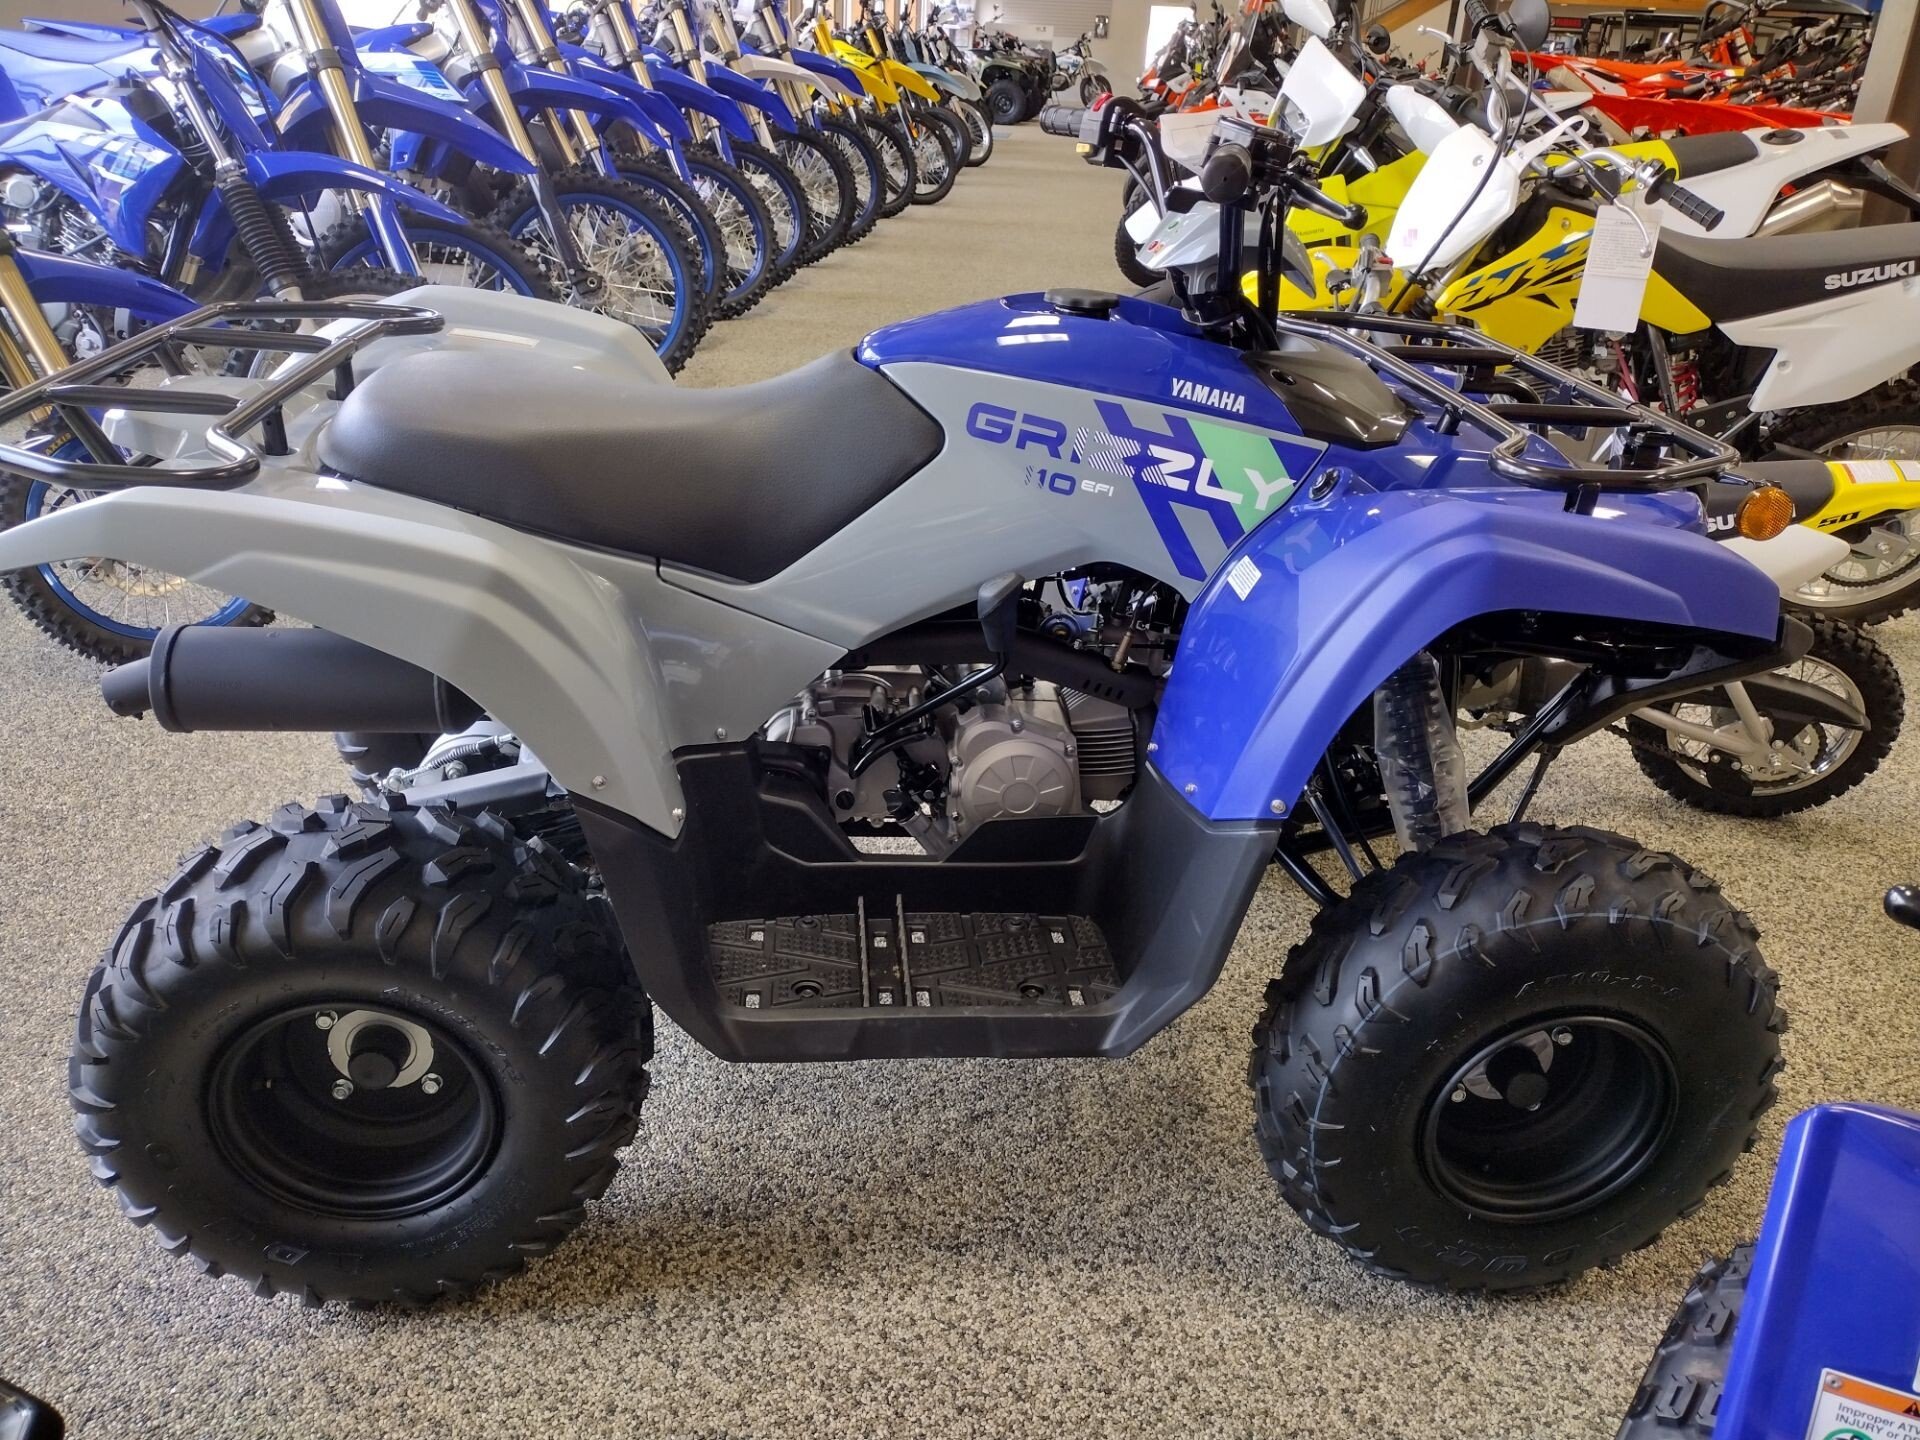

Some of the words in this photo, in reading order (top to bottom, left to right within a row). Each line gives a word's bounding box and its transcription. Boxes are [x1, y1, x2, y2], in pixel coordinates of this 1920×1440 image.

[1824, 260, 1916, 290] SUZUKI
[1171, 378, 1245, 415] YAMAHA
[966, 402, 1297, 511] GRIZZLY
[1081, 480, 1114, 497] EFI
[1817, 510, 1862, 529] 50
[1835, 1413, 1884, 1434] INJURY
[1886, 1430, 1899, 1440] or
[1838, 1402, 1895, 1427] Improper
